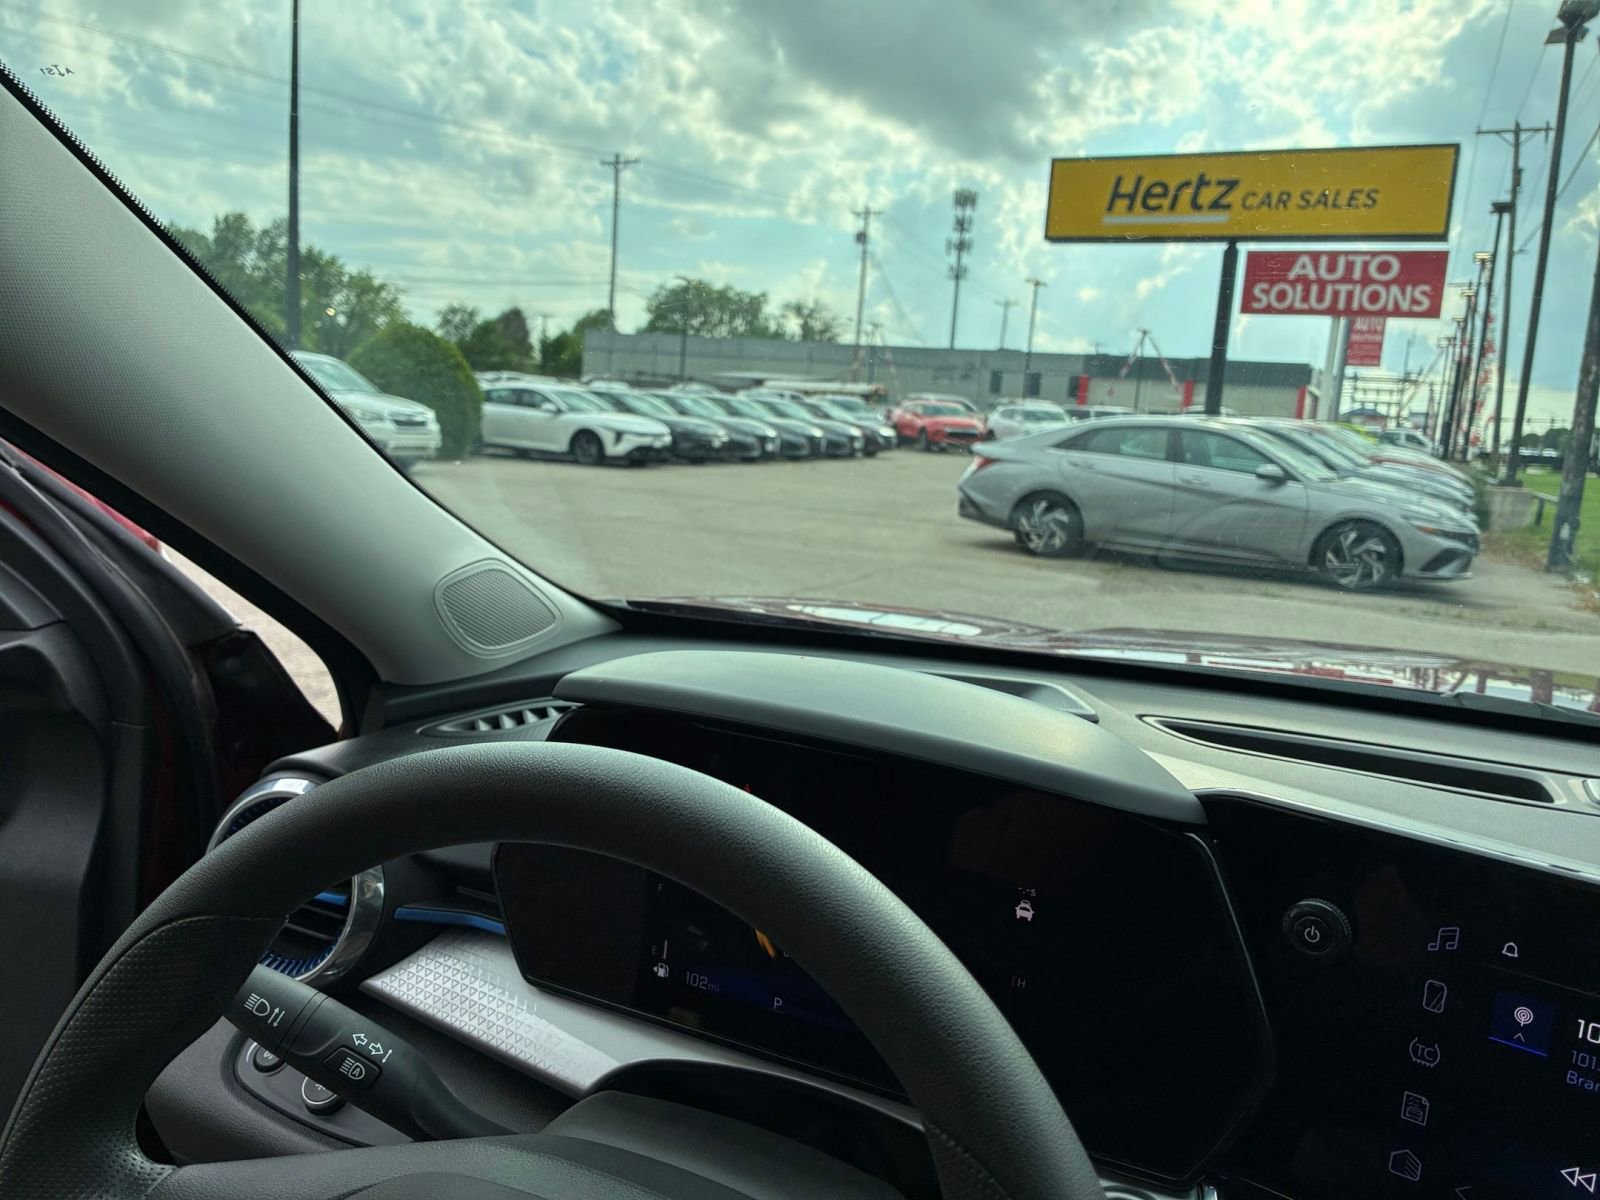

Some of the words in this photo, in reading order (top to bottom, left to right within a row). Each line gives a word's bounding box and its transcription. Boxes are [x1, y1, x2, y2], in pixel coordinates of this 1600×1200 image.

[1105, 172, 1240, 212] Hertz
[1241, 191, 1293, 210] CAR
[1297, 188, 1380, 210] SALES
[1287, 254, 1400, 282] AUTO
[1251, 281, 1432, 313] SOLUTIONS
[773, 997, 784, 1010] P
